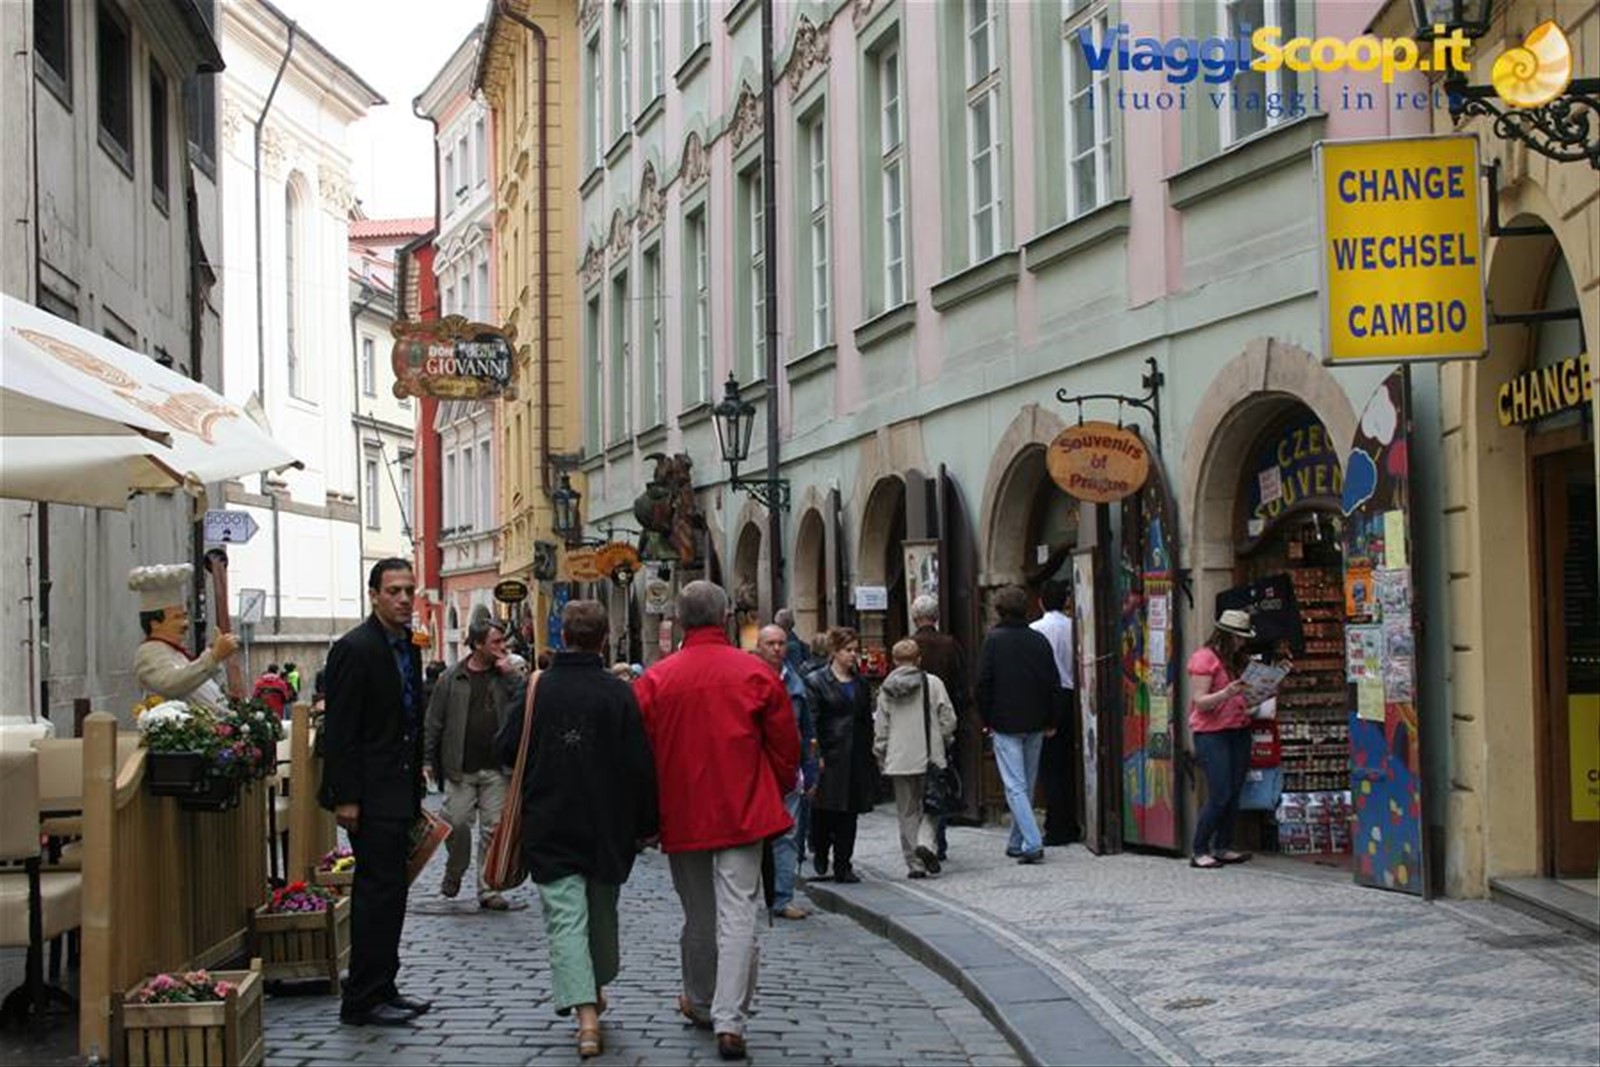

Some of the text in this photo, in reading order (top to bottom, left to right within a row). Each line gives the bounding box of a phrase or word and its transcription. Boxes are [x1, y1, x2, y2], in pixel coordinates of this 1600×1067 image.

[1338, 166, 1466, 203] CHANGE
[1333, 234, 1476, 271] WECHSEL
[1348, 300, 1468, 339] CAMBIO
[428, 345, 455, 357] DON
[426, 357, 508, 377] GIOVANNI
[1497, 353, 1593, 427] CHANGE
[1059, 435, 1143, 460] Souvenirs
[1090, 453, 1108, 469] of
[1069, 473, 1128, 494] Prague
